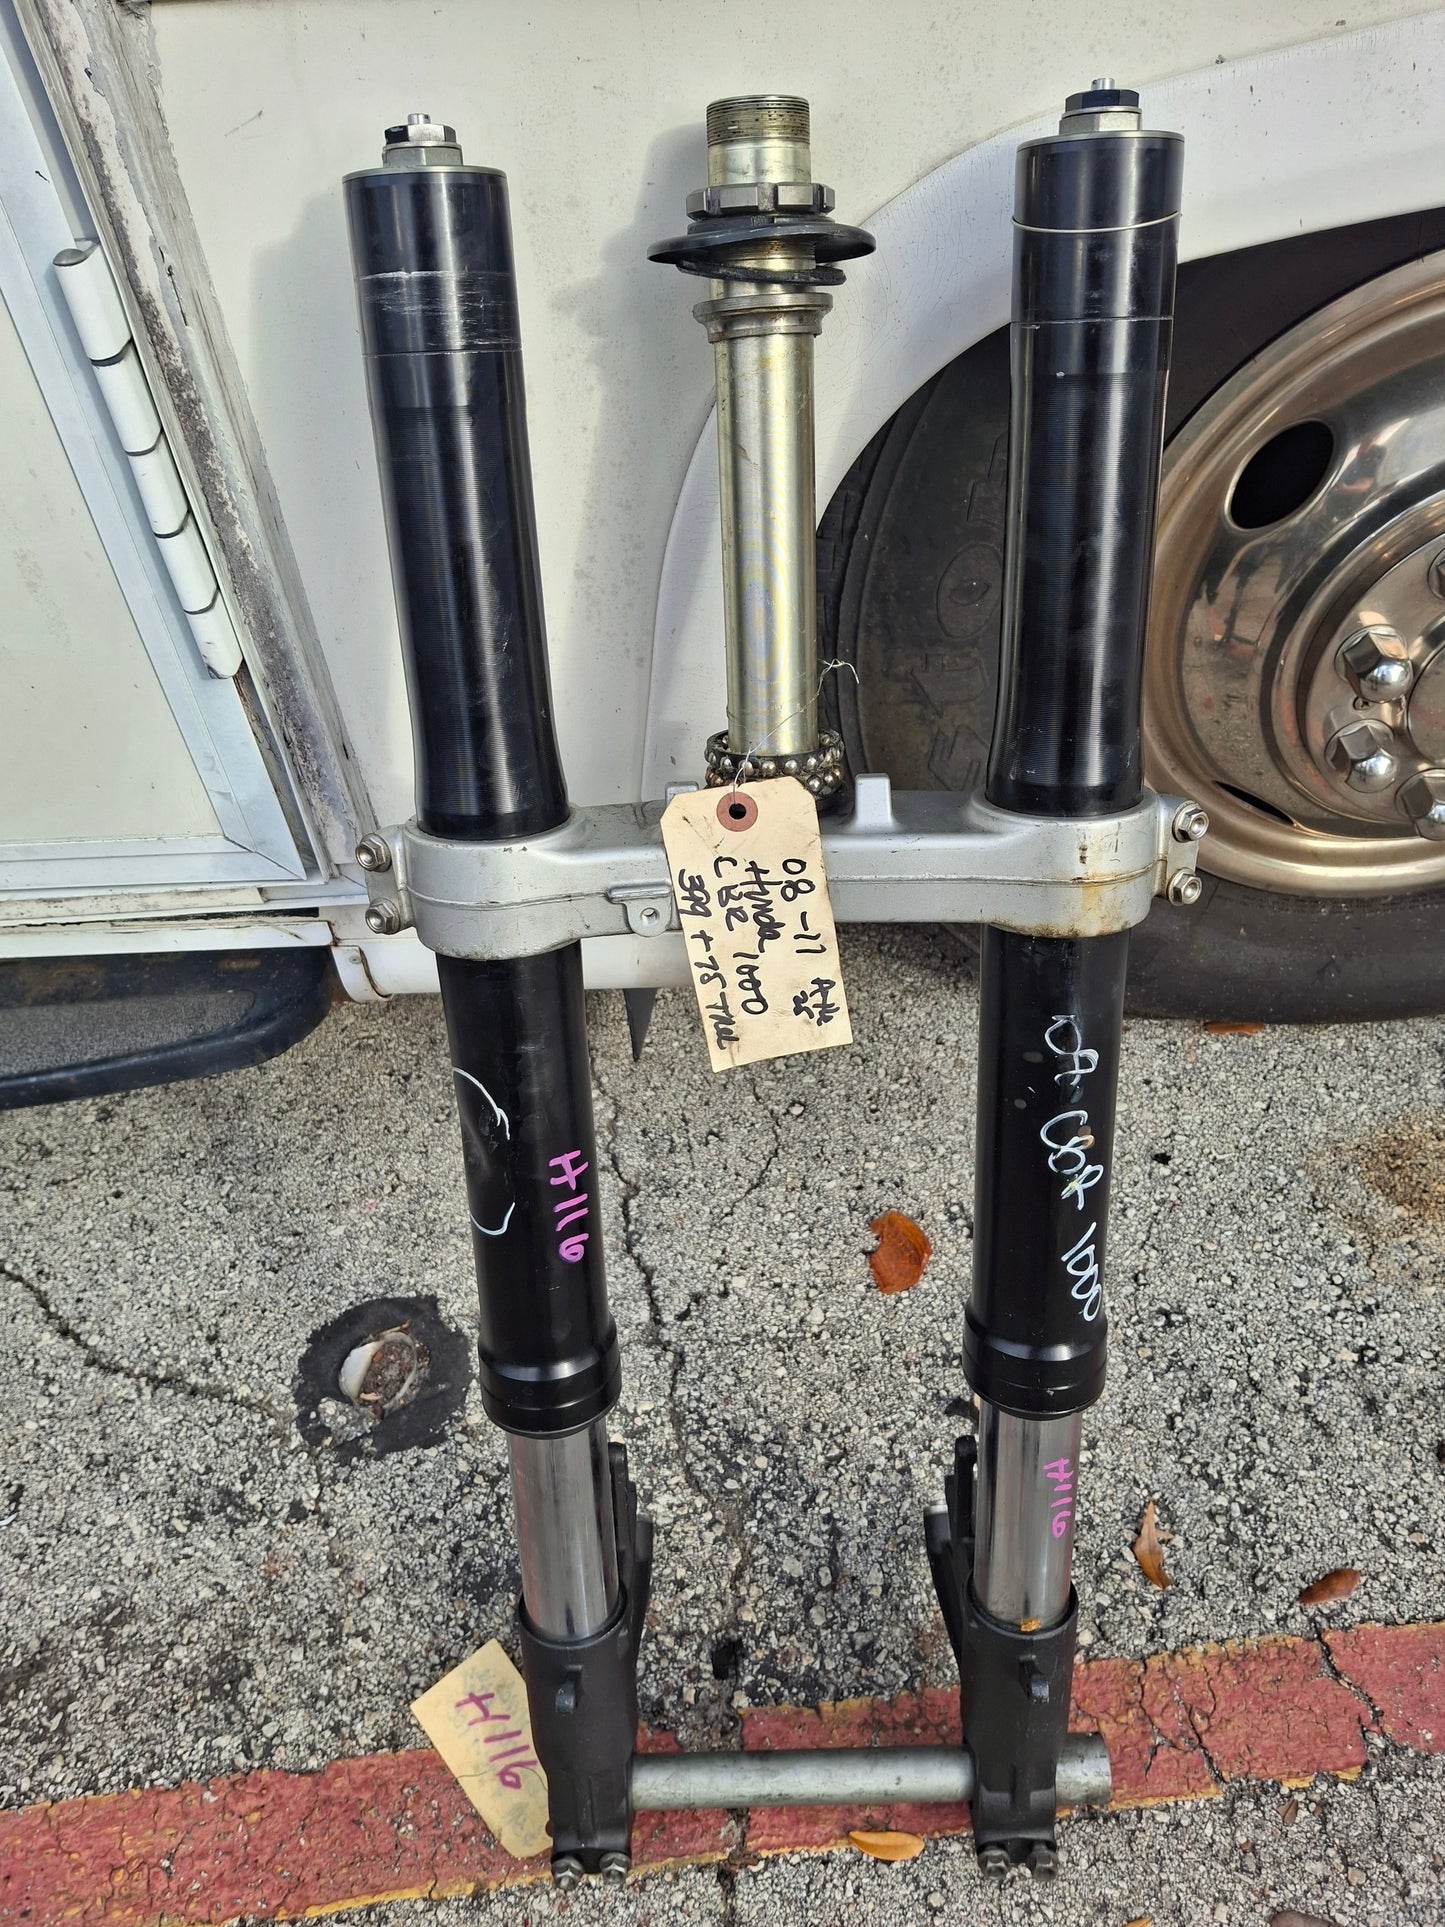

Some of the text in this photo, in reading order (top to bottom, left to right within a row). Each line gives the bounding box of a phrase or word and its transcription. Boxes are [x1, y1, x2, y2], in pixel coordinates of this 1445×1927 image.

[678, 868, 712, 918] 399
[713, 856, 769, 1015] CBR 1000
[549, 1150, 589, 1263] H116
[1061, 1221, 1103, 1322] 1000
[1043, 1457, 1074, 1539] H116
[456, 1692, 538, 1790] H116
